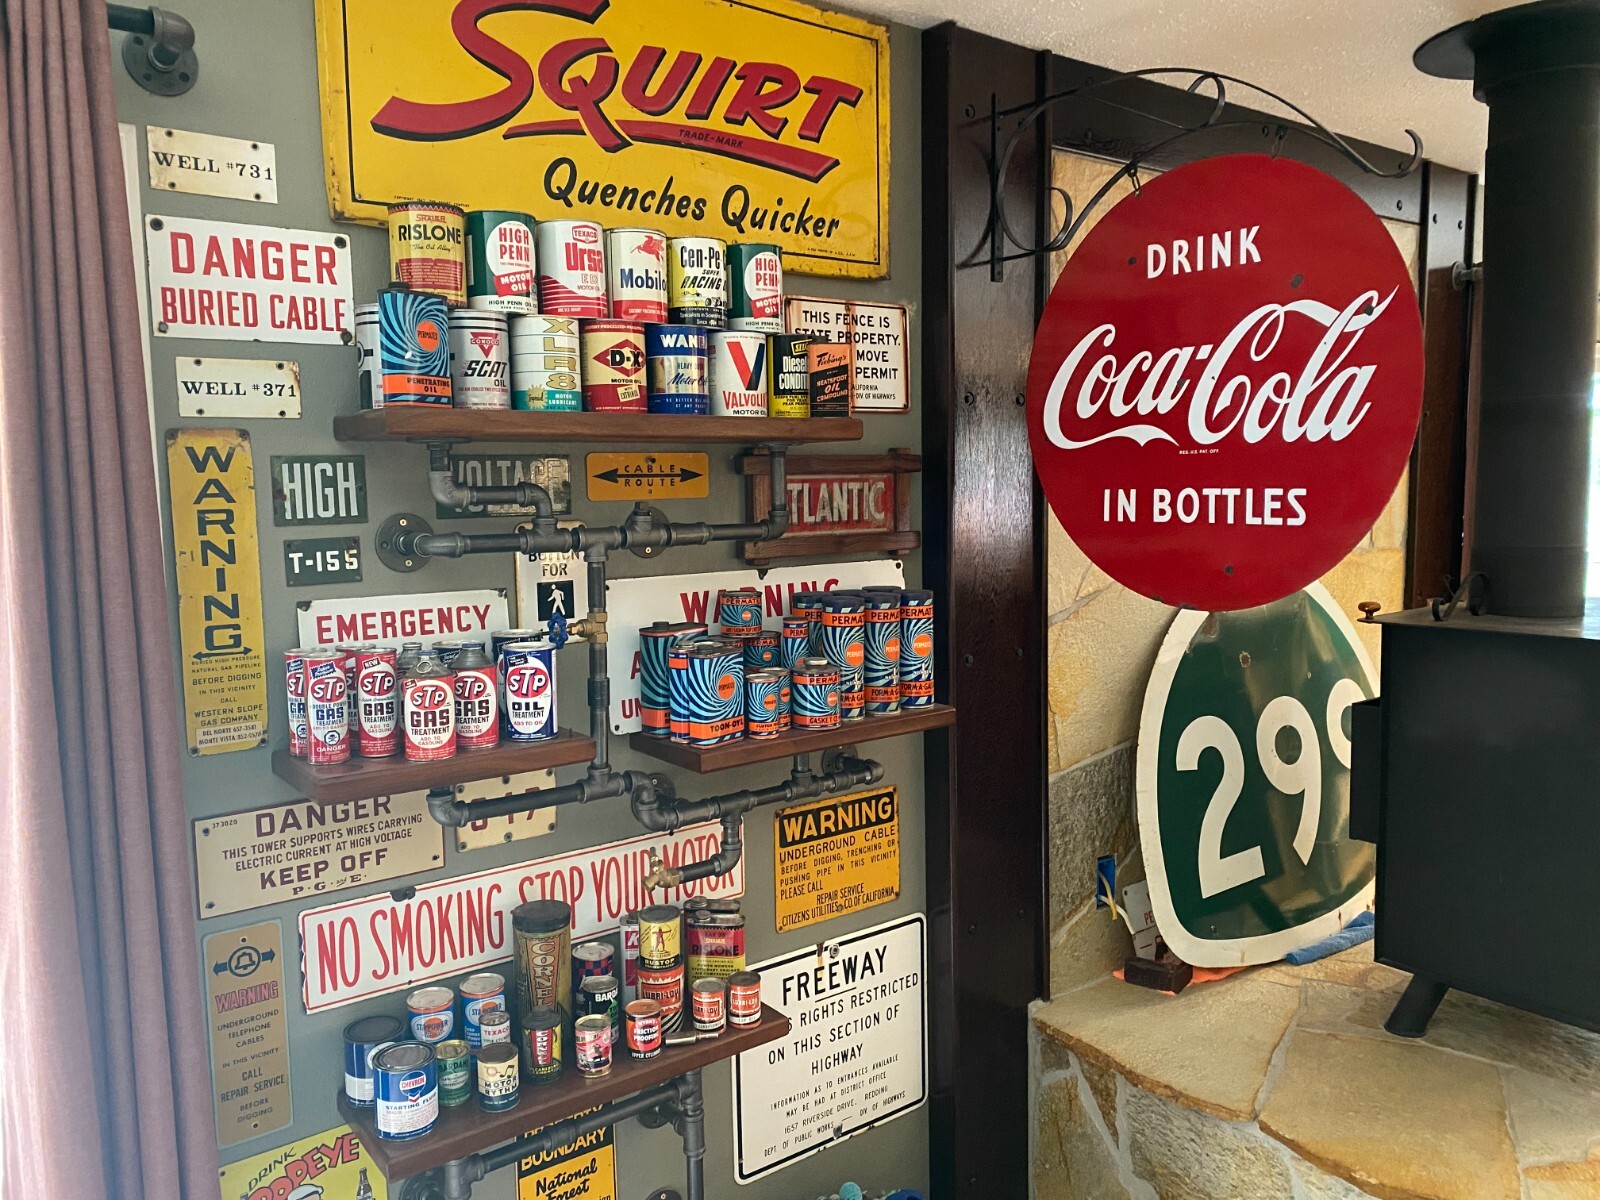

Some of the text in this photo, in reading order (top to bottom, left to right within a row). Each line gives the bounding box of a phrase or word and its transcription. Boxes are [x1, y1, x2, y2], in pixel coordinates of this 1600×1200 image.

[371, 0, 863, 153] SQUIRT
[678, 128, 744, 150] TRADE-MARK
[152, 150, 273, 181] WELL #731
[543, 157, 840, 239] Quenches Quicker
[398, 223, 462, 245] RISLONE
[498, 227, 530, 246] HIGH
[573, 228, 598, 239] TEXACO
[170, 231, 337, 285] DANGER
[499, 244, 530, 262] PENN
[564, 242, 604, 273] Ursa
[1146, 225, 1261, 280] DRINK
[500, 272, 532, 285] MOTOR
[511, 282, 527, 293] OIL
[680, 275, 722, 290] RACING
[160, 286, 348, 332] BURIED CABLE
[803, 310, 890, 328] THIS FENCE IS
[470, 337, 499, 346] CONOCO
[609, 349, 642, 368] D-X
[816, 352, 847, 368] Fiebing's
[856, 350, 889, 362] MOVE
[463, 360, 508, 378] SCAT
[855, 366, 898, 379] PERMIT
[1043, 284, 1400, 450] Coca-Cola
[181, 380, 296, 398] WELL #371
[407, 377, 450, 388] PENETRATING
[424, 385, 438, 394] OIL
[494, 378, 507, 388] OIL
[816, 374, 848, 387] NEATSFOOT
[824, 382, 841, 394] OIL
[816, 389, 848, 403] COMPOUND
[624, 463, 676, 474] CABLE
[282, 462, 358, 520] HIGH
[623, 476, 676, 488] ROUTE
[787, 481, 885, 525] TLANTIC
[1103, 487, 1307, 526] IN BOTTLES
[185, 446, 242, 651] WARNING
[288, 549, 359, 575] T-155
[542, 563, 568, 577] FOR
[316, 604, 491, 644] EMERGENCY
[364, 658, 380, 670] NEW
[192, 672, 262, 686] BEFORE DIGGING
[313, 678, 345, 700] STP
[362, 672, 394, 694] STP
[509, 669, 547, 695] STP
[412, 686, 445, 708] STP
[511, 701, 545, 711] OIL
[194, 704, 264, 718] WESTERN SLOPE
[363, 701, 394, 716] GAS
[410, 708, 450, 728] GAS
[512, 710, 544, 719] TREATMENT
[200, 713, 259, 727] GAS COMPANY
[709, 720, 744, 733] TOON-OYL
[410, 726, 450, 736] TREATMENT
[255, 795, 391, 838] DANGER
[783, 797, 892, 843] WARNING
[222, 813, 423, 861] THIS TOWER SUPPORTS WIRES CARRYING
[779, 825, 896, 864] UNDERGROUND CABLE
[235, 828, 412, 872] ELECTRIC CURRENT AT HIGH VOLTAGE
[781, 861, 807, 875] BEFORE
[847, 842, 882, 858] TRENCHING
[887, 839, 896, 848] OR
[260, 848, 388, 890] KEEP OFF
[780, 849, 897, 888] PUSHING PIPE IN THIS VICINITY
[780, 880, 823, 901] PLEASE CALL
[816, 882, 865, 906] REPAIR SERVICE
[781, 909, 810, 927] CITIZENS
[811, 901, 839, 919] UTILITIES
[862, 885, 895, 904] CALIFORNIA
[316, 916, 361, 995] NO
[372, 883, 504, 981] SMOKING
[644, 958, 675, 966] RUSTOP
[782, 945, 887, 1007] FREEWAY
[215, 980, 279, 1014] WARNING
[800, 999, 844, 1028] RIGHTS
[850, 972, 918, 1010] RESTRICTED
[217, 1009, 279, 1031] UNDERGROUND
[633, 1024, 659, 1035] FRICTION
[228, 1022, 272, 1040] TELEPHONE
[235, 1034, 265, 1048] CABLES
[768, 1004, 900, 1066] ON THIS SECTION OF
[811, 1043, 864, 1076] HIGHWAY
[241, 1066, 264, 1082] CALL
[401, 1075, 426, 1090] CHEVRON
[484, 1075, 518, 1089] MOTOR
[770, 1053, 899, 1111] INFORMATION AS TO ENTRANCES AVAILABLE
[220, 1073, 286, 1104] REPAIR SERVICE
[484, 1082, 519, 1095] RYTHM
[786, 1071, 887, 1118] MAY BE HAD AT DISTRICT OFFICE
[237, 1106, 274, 1124] DIGGING
[385, 1102, 420, 1110] STARTING
[784, 1122, 799, 1135] 1657
[802, 1108, 833, 1127] RIVERSIDE
[864, 1085, 888, 1101] REDDING
[794, 1129, 812, 1144] PUBLIC
[248, 1146, 297, 1190] DRINK
[536, 1157, 598, 1196] National
[545, 1178, 590, 1200] Forest
